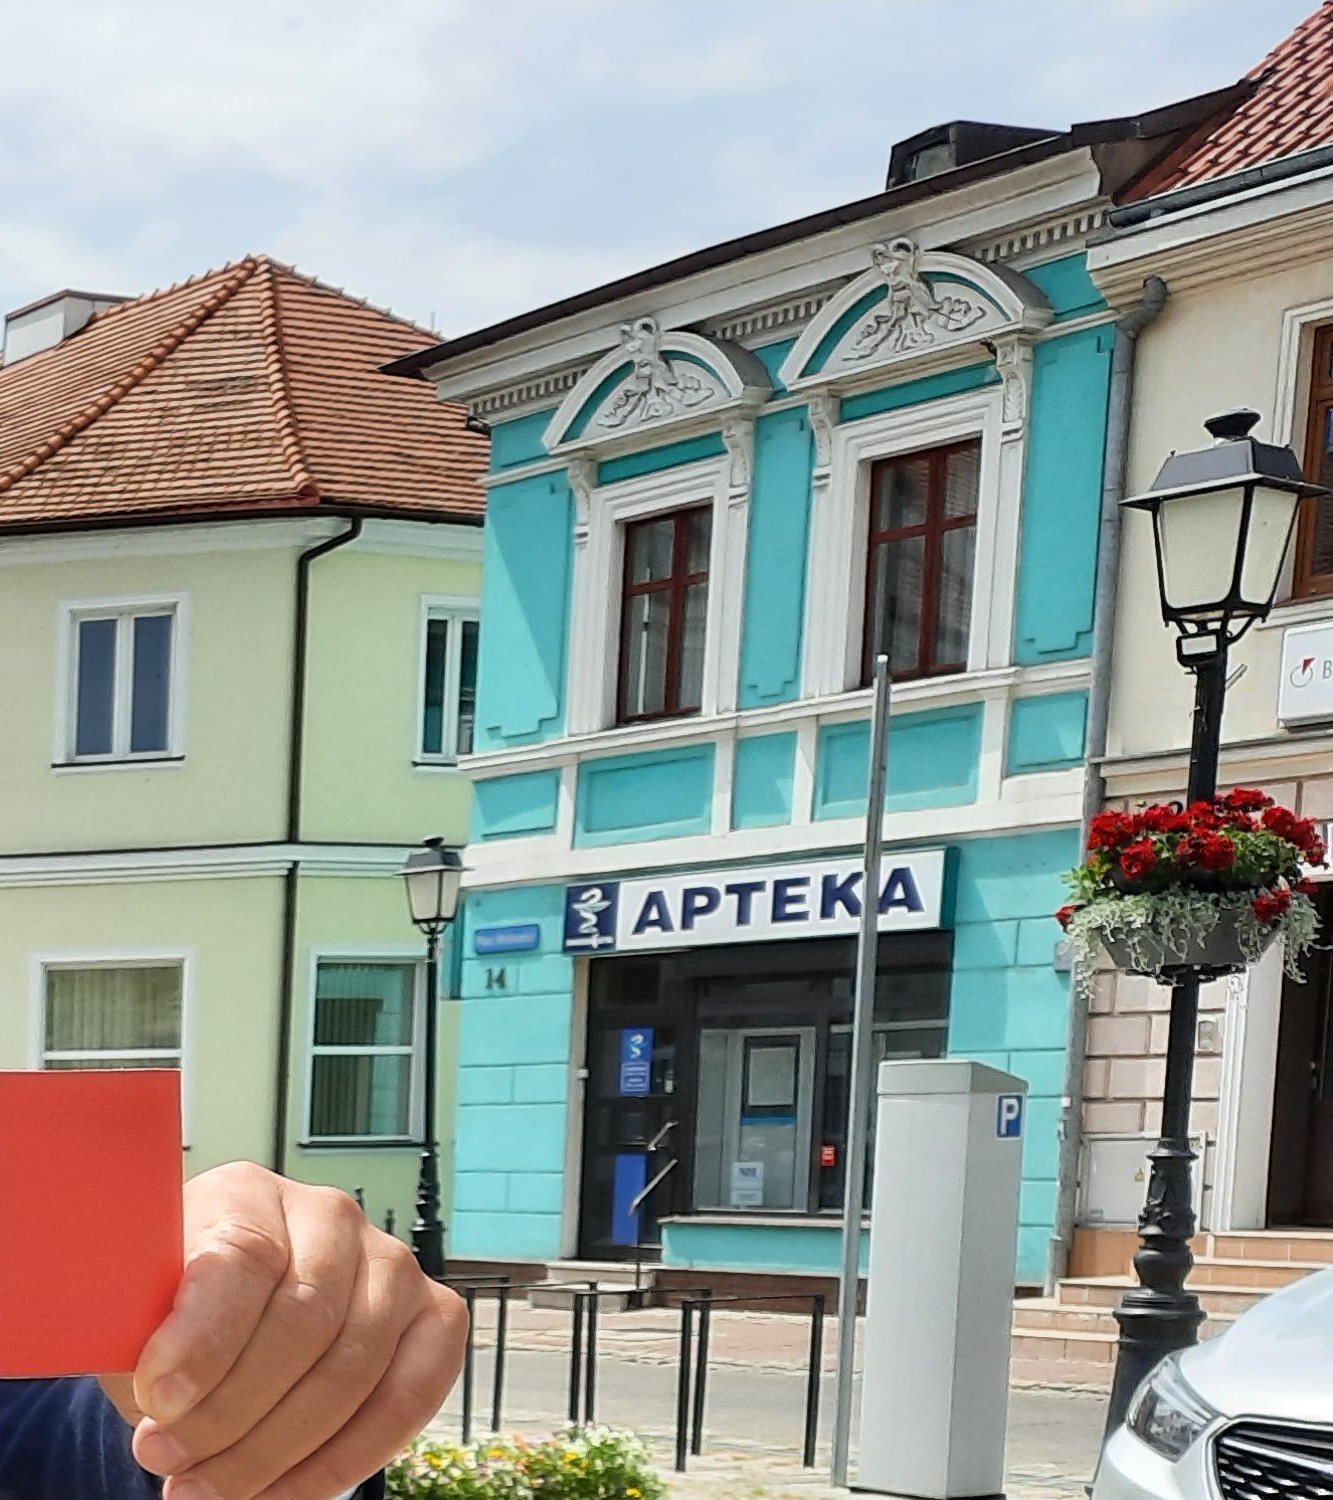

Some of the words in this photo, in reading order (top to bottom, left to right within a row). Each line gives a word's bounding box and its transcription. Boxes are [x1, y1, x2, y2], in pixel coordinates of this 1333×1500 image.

[631, 866, 926, 936] APTEKA
[485, 967, 508, 990] 14
[1000, 1098, 1020, 1136] P
